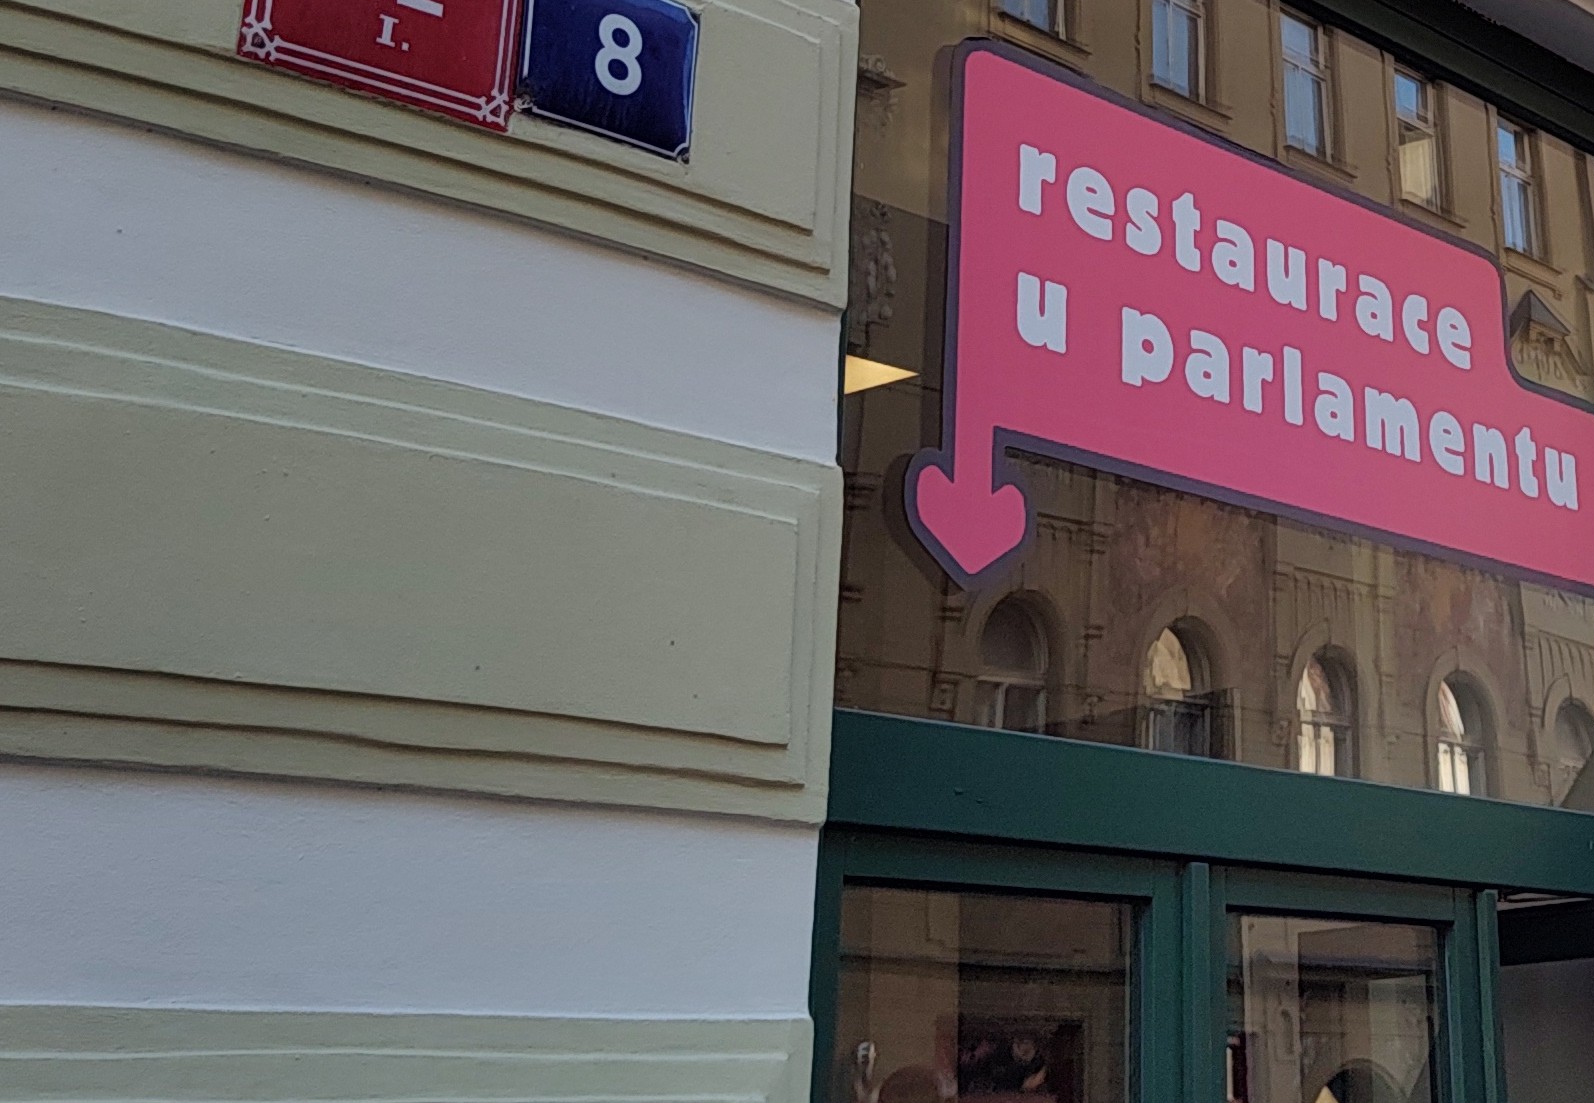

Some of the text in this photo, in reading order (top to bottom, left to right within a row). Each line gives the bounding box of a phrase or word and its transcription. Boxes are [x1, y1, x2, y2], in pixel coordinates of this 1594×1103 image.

[376, 13, 410, 52] I.
[594, 13, 643, 96] 8
[1017, 142, 1473, 371] restaurace
[1015, 270, 1579, 512] u parlamentu
